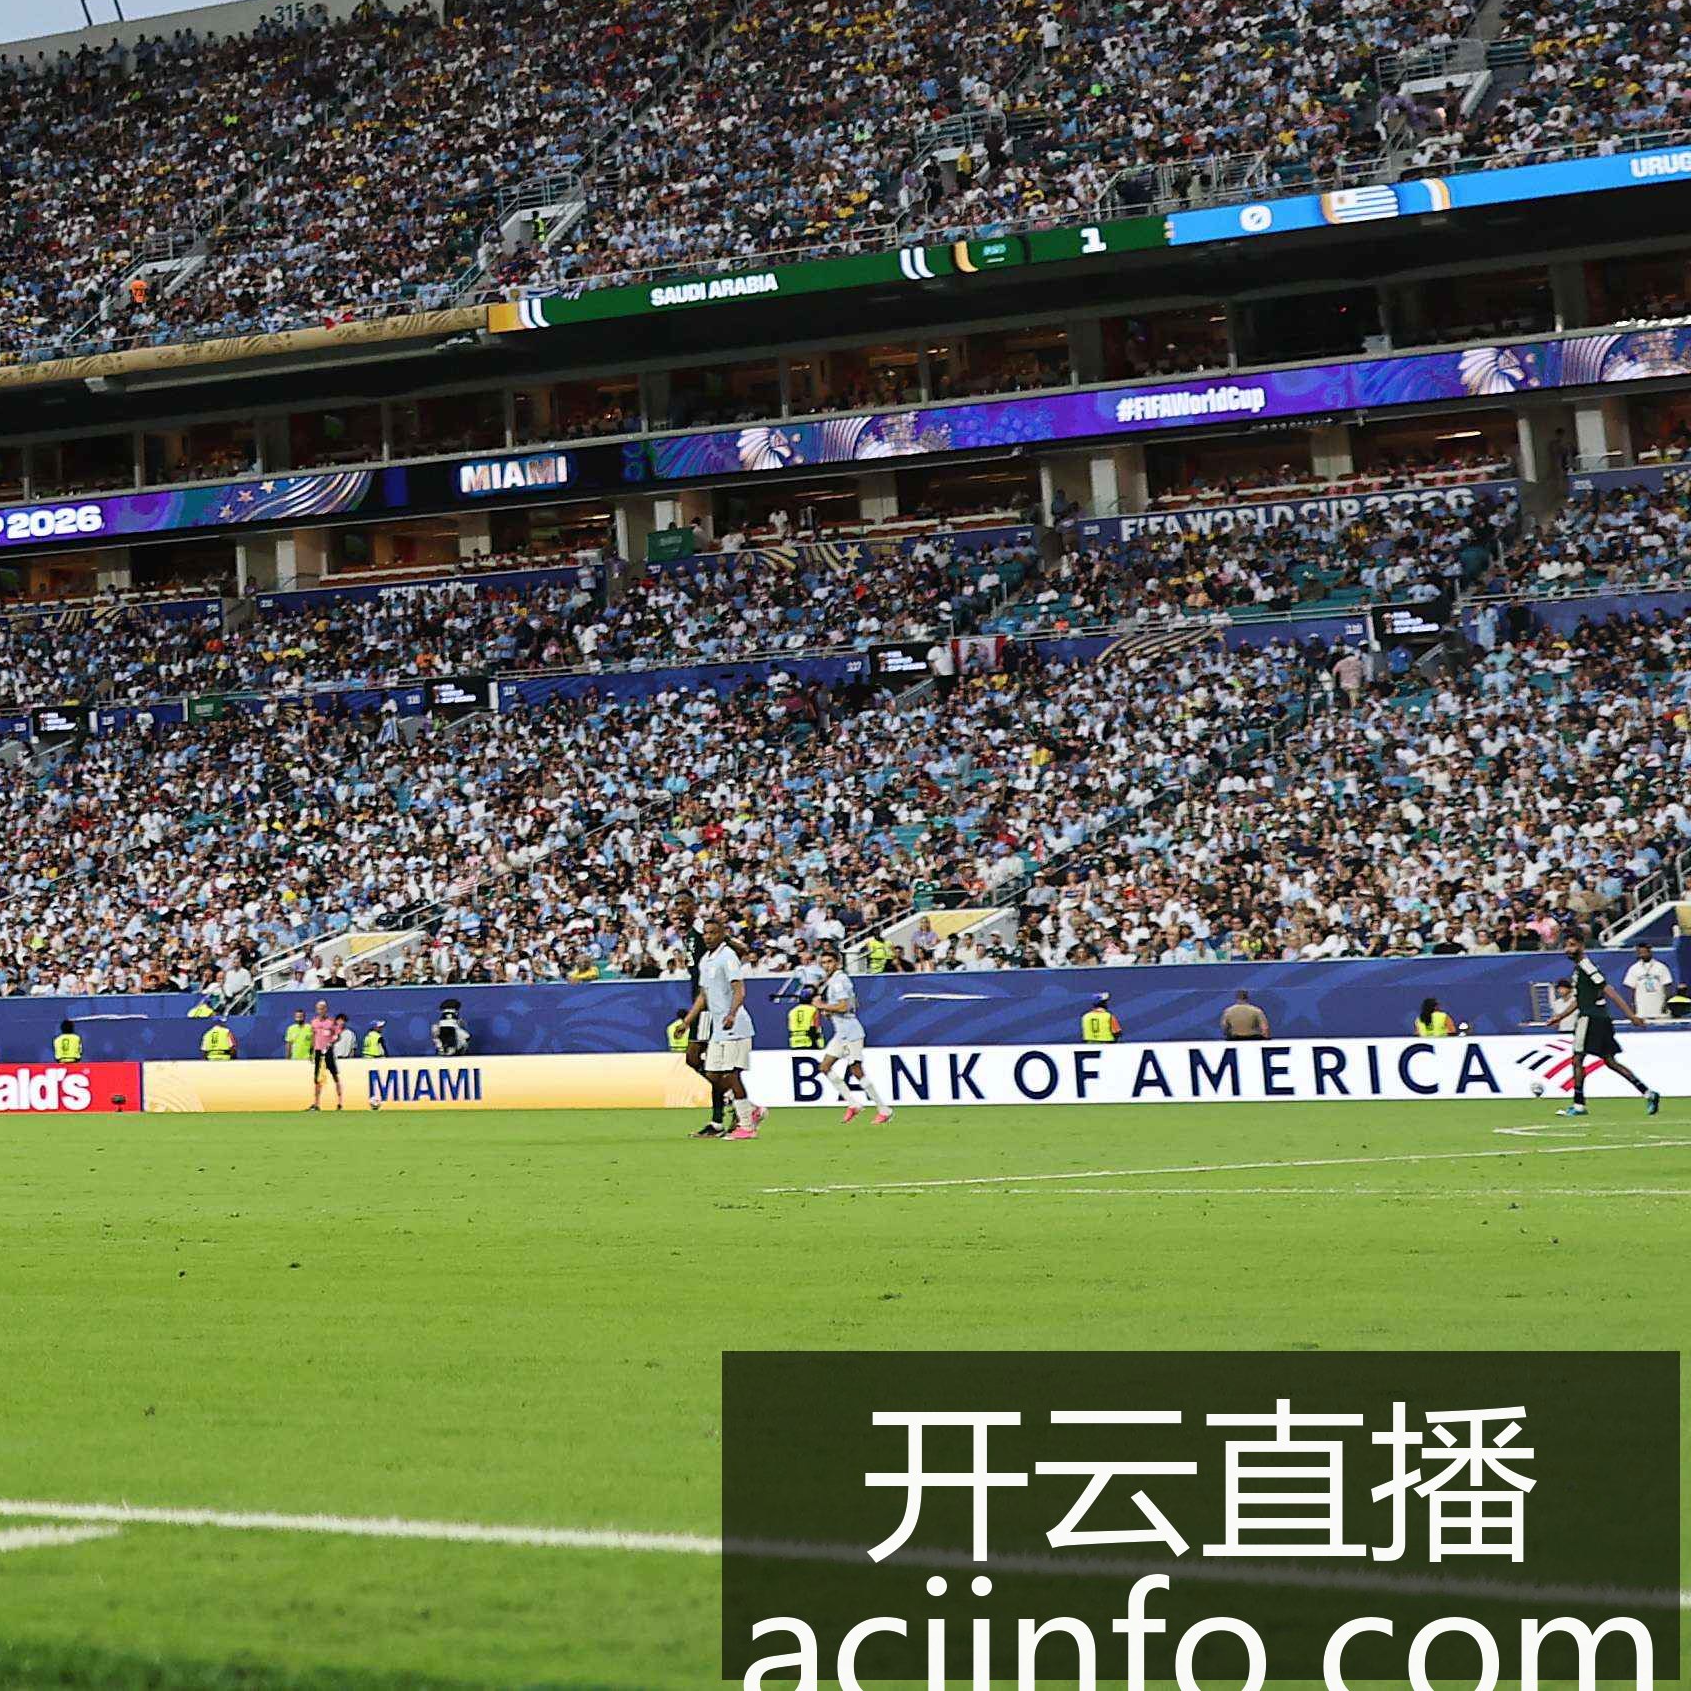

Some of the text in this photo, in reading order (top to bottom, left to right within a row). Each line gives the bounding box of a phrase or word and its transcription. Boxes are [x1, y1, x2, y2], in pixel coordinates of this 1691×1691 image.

[274, 2, 306, 22] 315
[1239, 205, 1272, 232] 0
[1080, 227, 1107, 253] 1
[650, 273, 778, 306] SAUDI ARABIA
[1116, 386, 1265, 422] #FIFAWorldCup
[459, 455, 568, 494] MIAMI
[6, 505, 103, 539] 2026
[369, 1068, 482, 1103] MIAMI
[1013, 1050, 1102, 1100] OF
[1133, 1042, 1500, 1097] AMERICA
